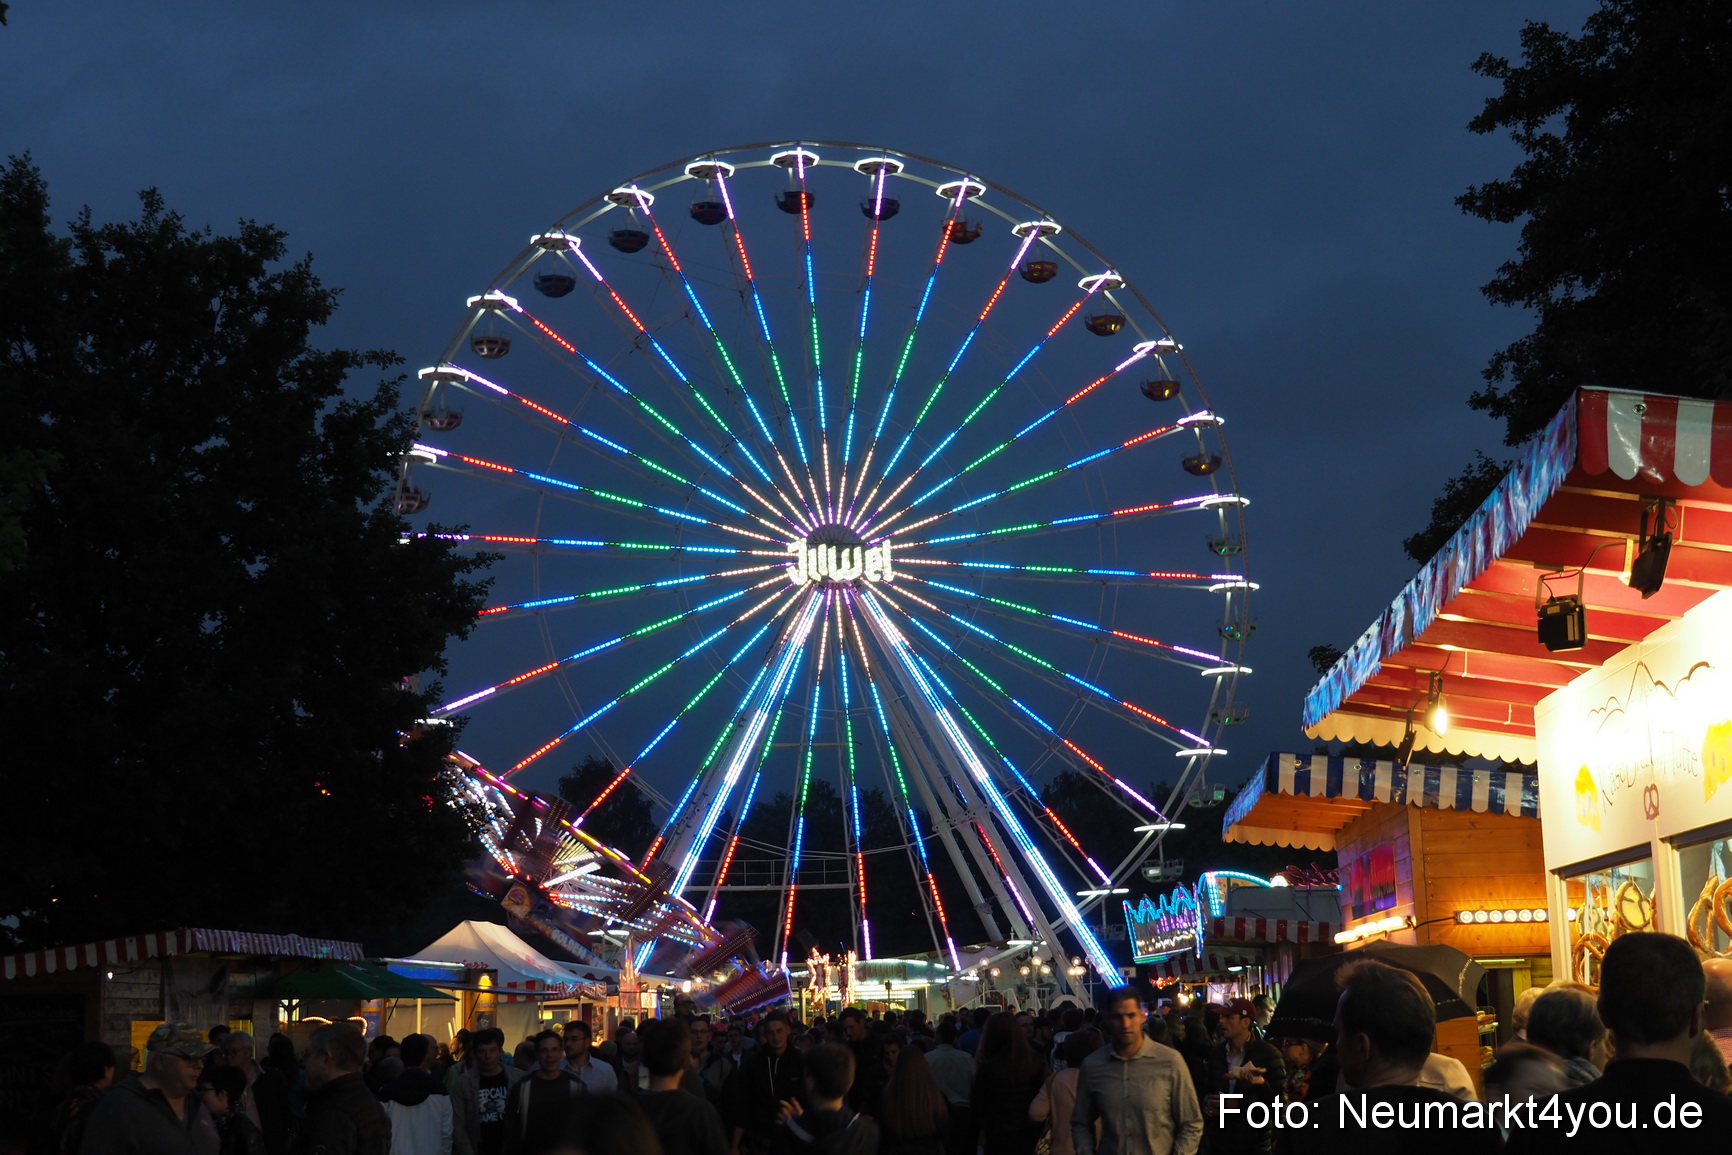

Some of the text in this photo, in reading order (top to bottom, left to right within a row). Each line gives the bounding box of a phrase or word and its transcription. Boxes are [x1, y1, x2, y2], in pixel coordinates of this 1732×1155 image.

[786, 537, 894, 586] Juwel
[551, 929, 587, 960] GOLDEN
[479, 1112, 498, 1123] AME
